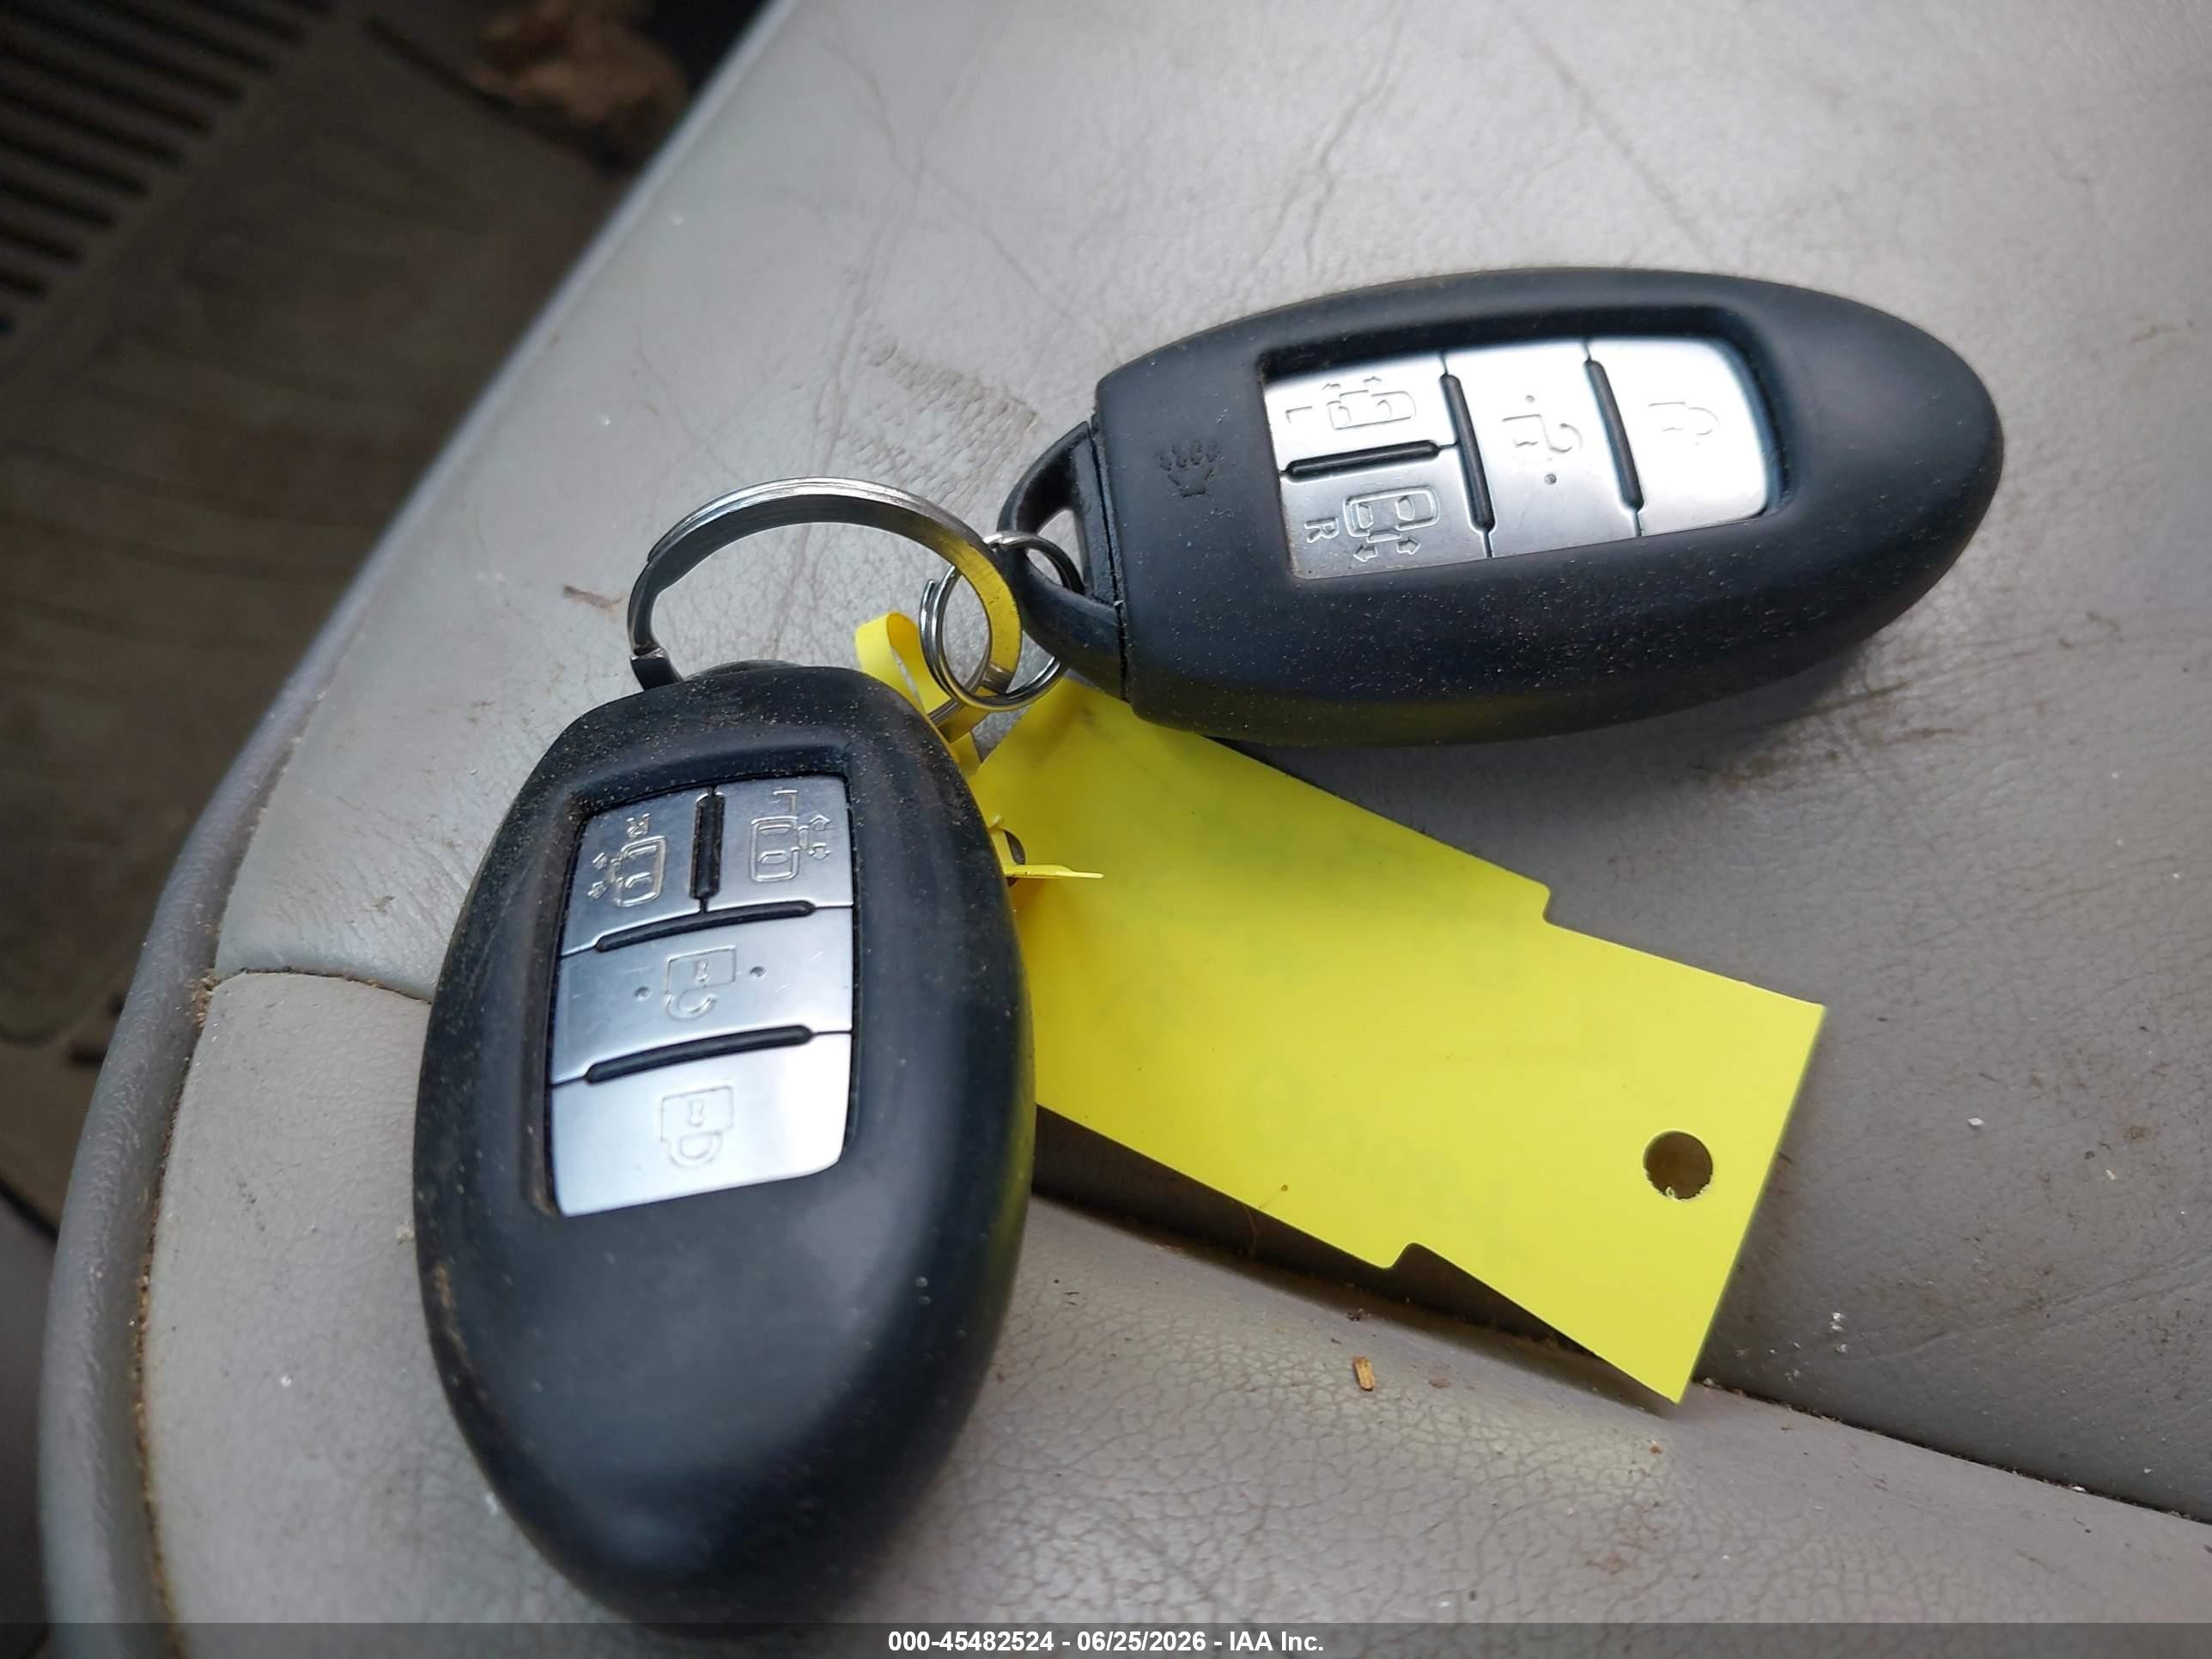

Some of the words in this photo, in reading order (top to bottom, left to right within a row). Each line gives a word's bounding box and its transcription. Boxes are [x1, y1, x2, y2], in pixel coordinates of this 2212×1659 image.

[1304, 515, 1340, 544] R
[773, 788, 799, 811] L
[626, 812, 651, 838] R
